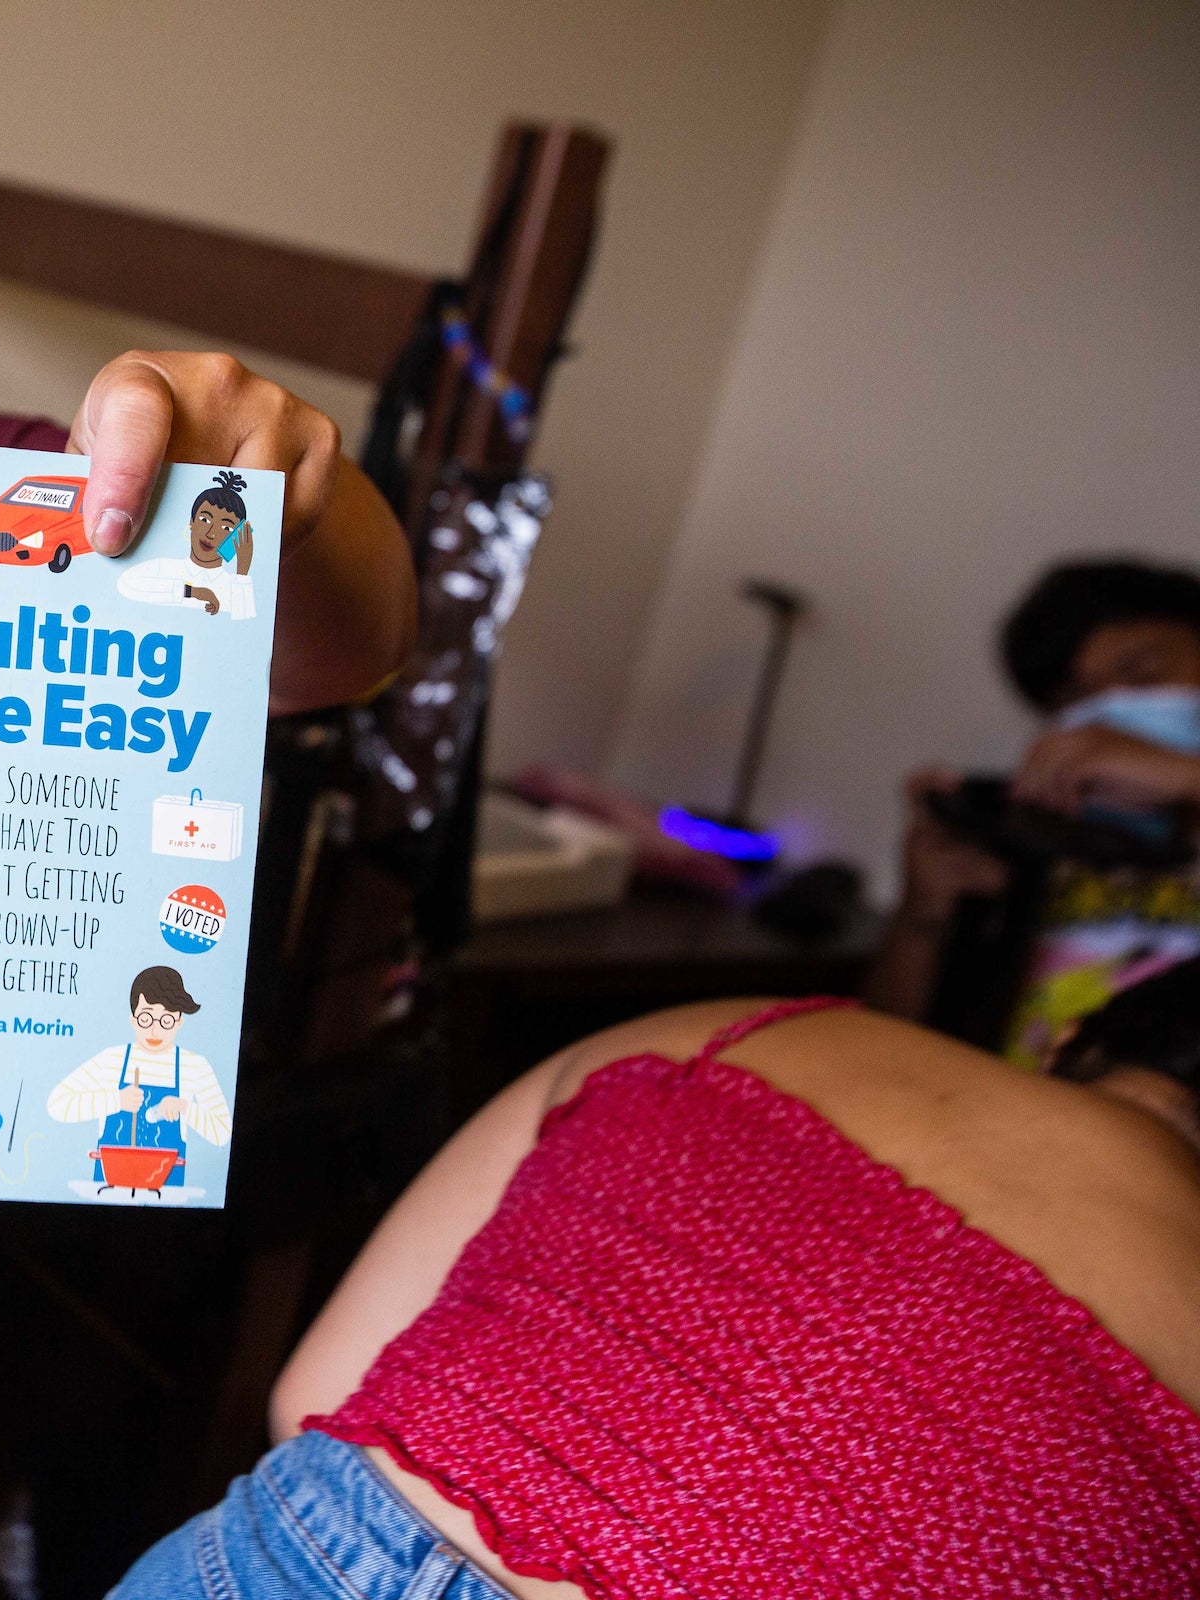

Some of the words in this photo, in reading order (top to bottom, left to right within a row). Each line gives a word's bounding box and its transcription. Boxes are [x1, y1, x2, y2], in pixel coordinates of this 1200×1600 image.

[17, 488, 35, 500] 0%
[33, 490, 70, 505] FINANCE
[42, 681, 212, 773] Easy
[5, 766, 120, 811] SOMEONE
[1, 813, 55, 853] HAVE
[64, 818, 118, 857] TOLD
[168, 839, 197, 848] FIRST
[25, 863, 124, 904] GETTING
[165, 903, 173, 921] I
[176, 905, 220, 935] VOTED
[13, 1017, 74, 1037] Morin
